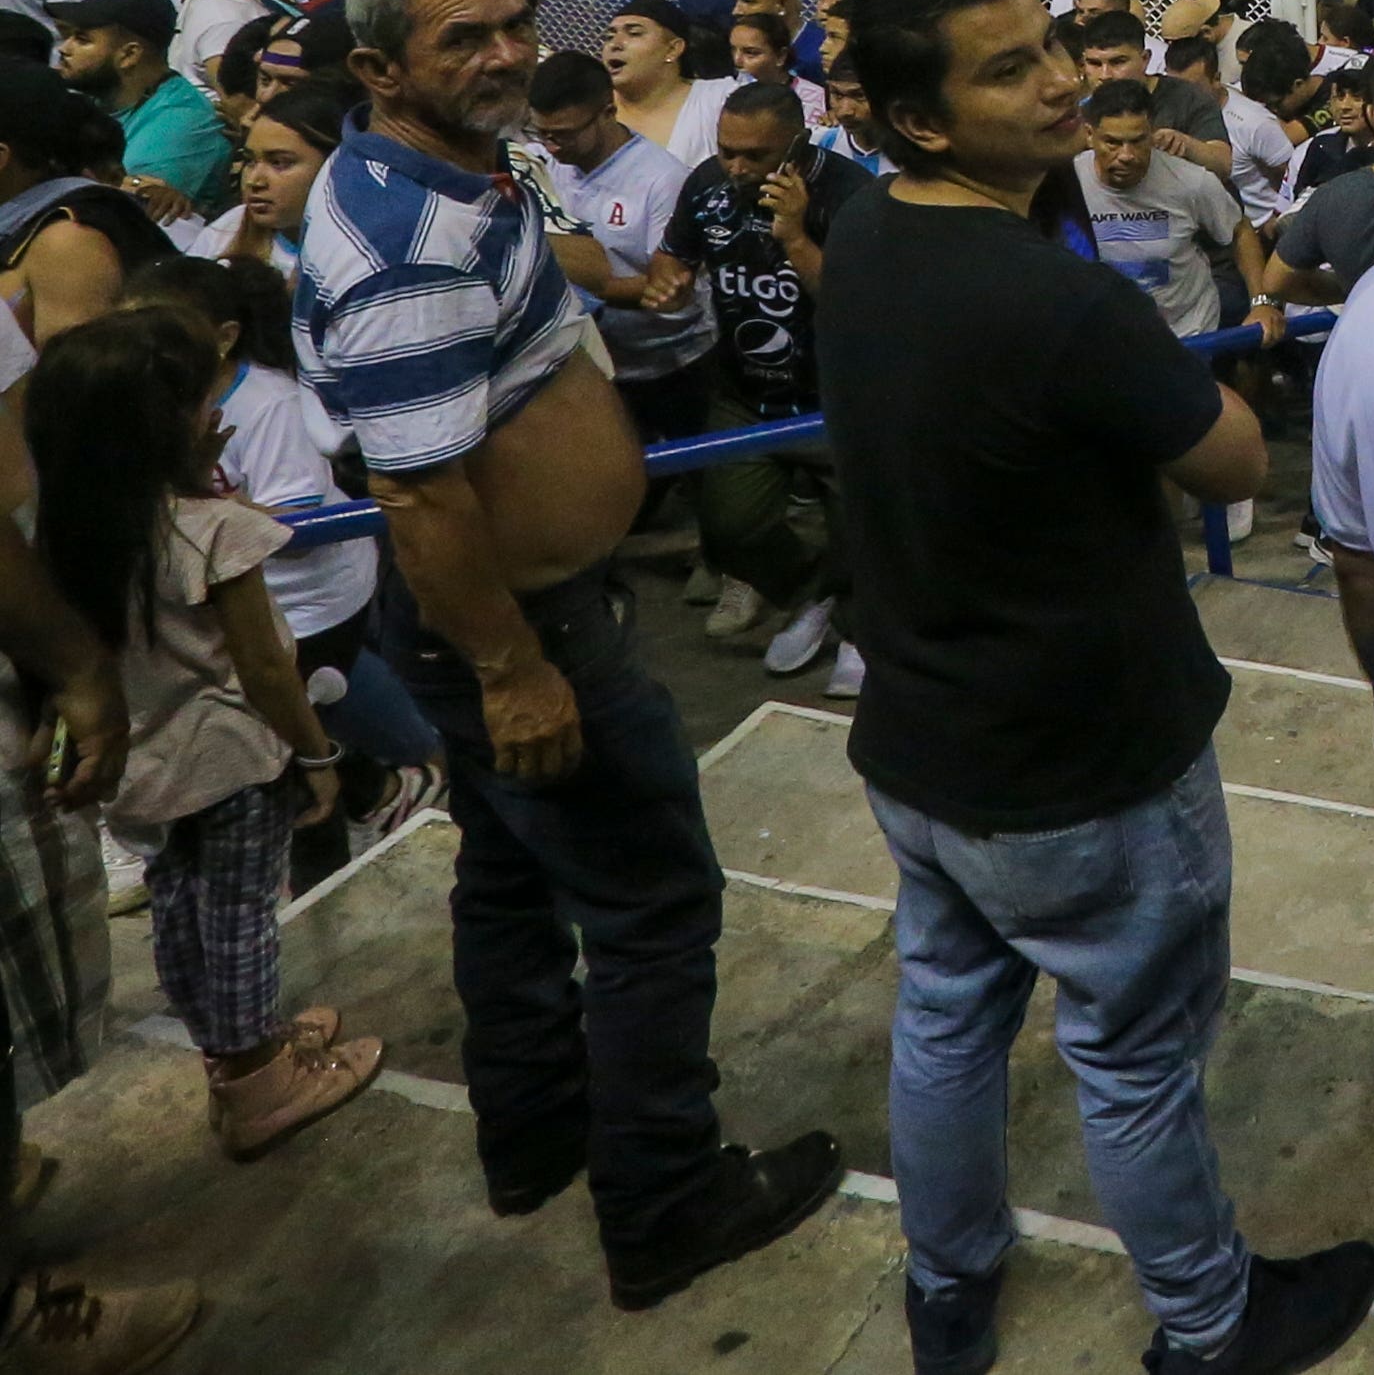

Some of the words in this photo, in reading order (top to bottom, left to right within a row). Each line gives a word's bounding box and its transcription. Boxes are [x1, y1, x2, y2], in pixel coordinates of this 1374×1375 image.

[608, 202, 626, 226] A
[1091, 213, 1118, 223] AKE
[1120, 210, 1169, 221] WAVES
